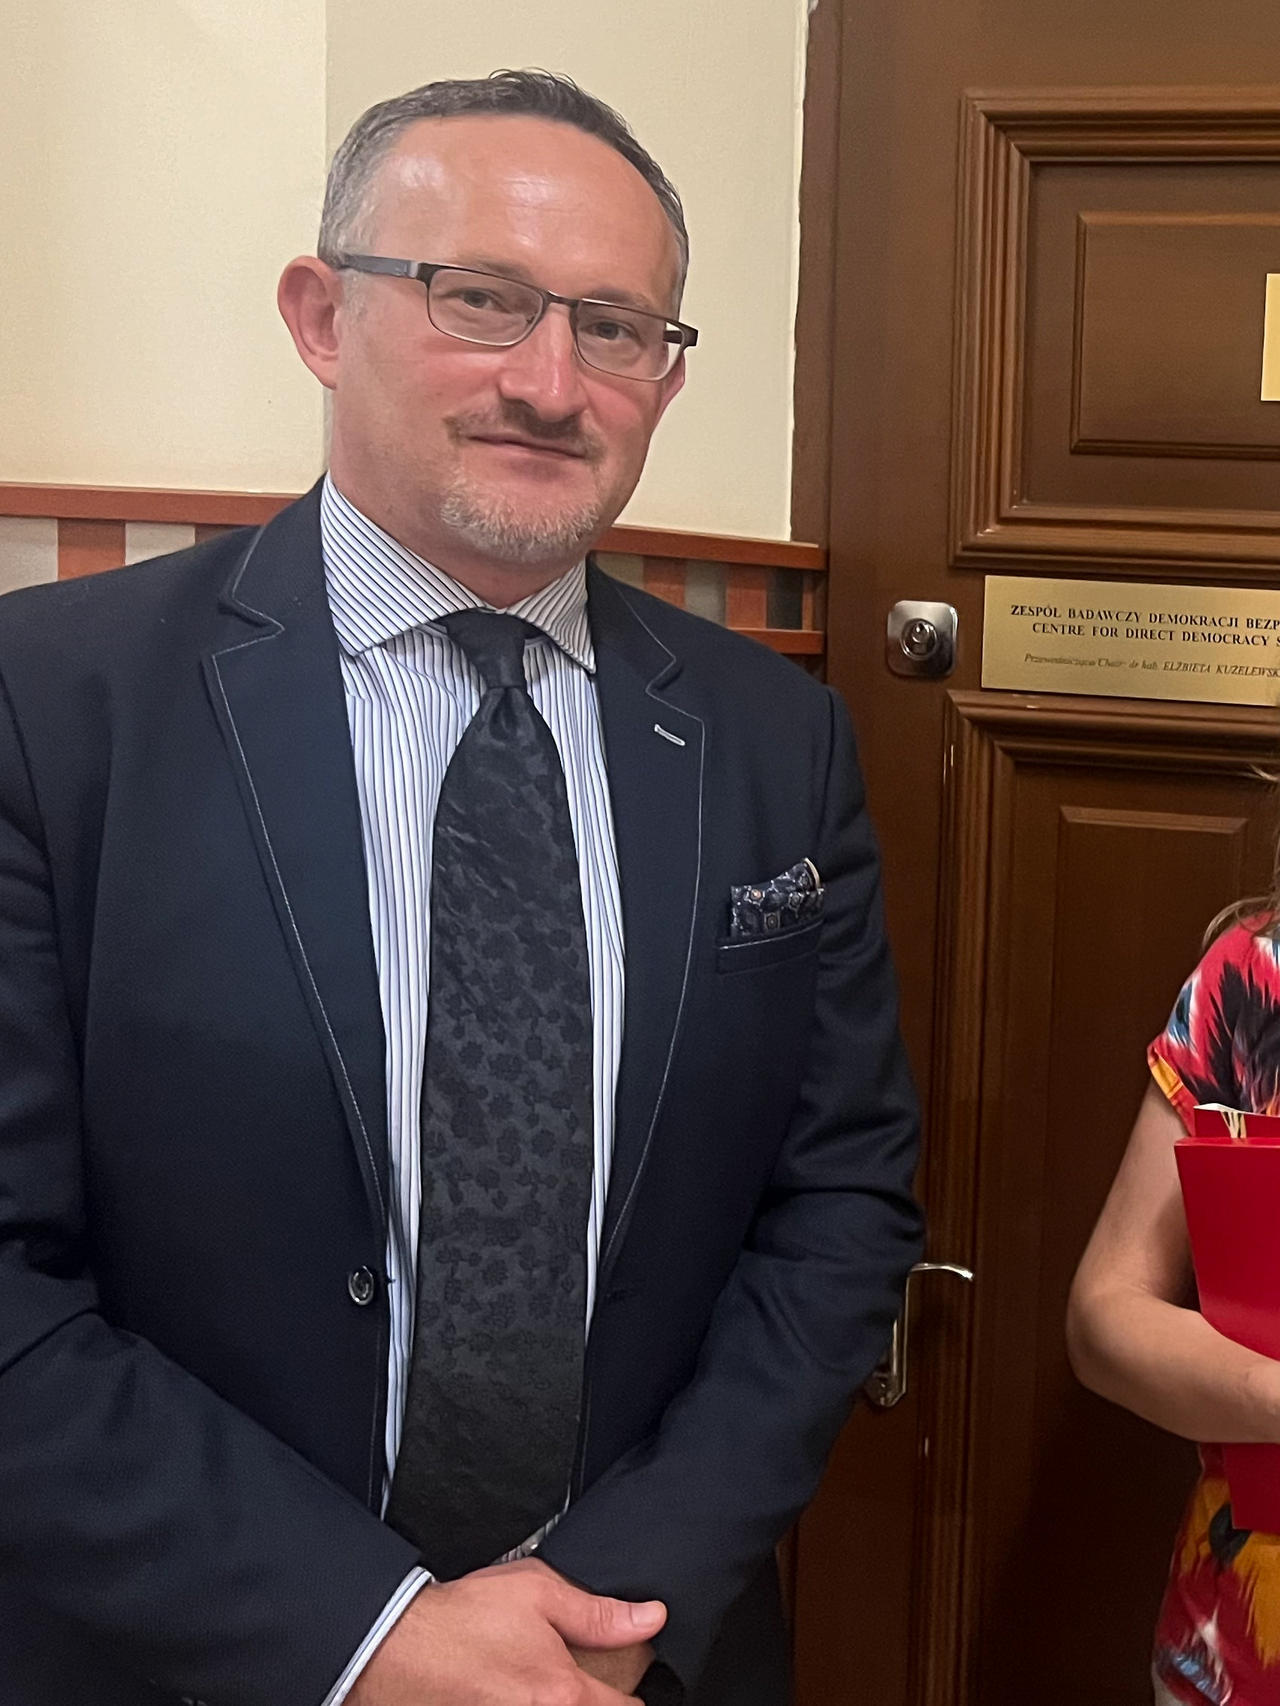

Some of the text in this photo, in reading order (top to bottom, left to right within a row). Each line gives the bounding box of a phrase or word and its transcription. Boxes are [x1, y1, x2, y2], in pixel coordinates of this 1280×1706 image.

[1068, 608, 1142, 624] BADAWCZY
[1149, 612, 1239, 628] DEMOKRACJI
[1032, 622, 1086, 636] CENTRE
[1092, 626, 1119, 638] FOR
[1126, 627, 1175, 641] DIRECT
[1182, 631, 1269, 647] DEMOCRACY
